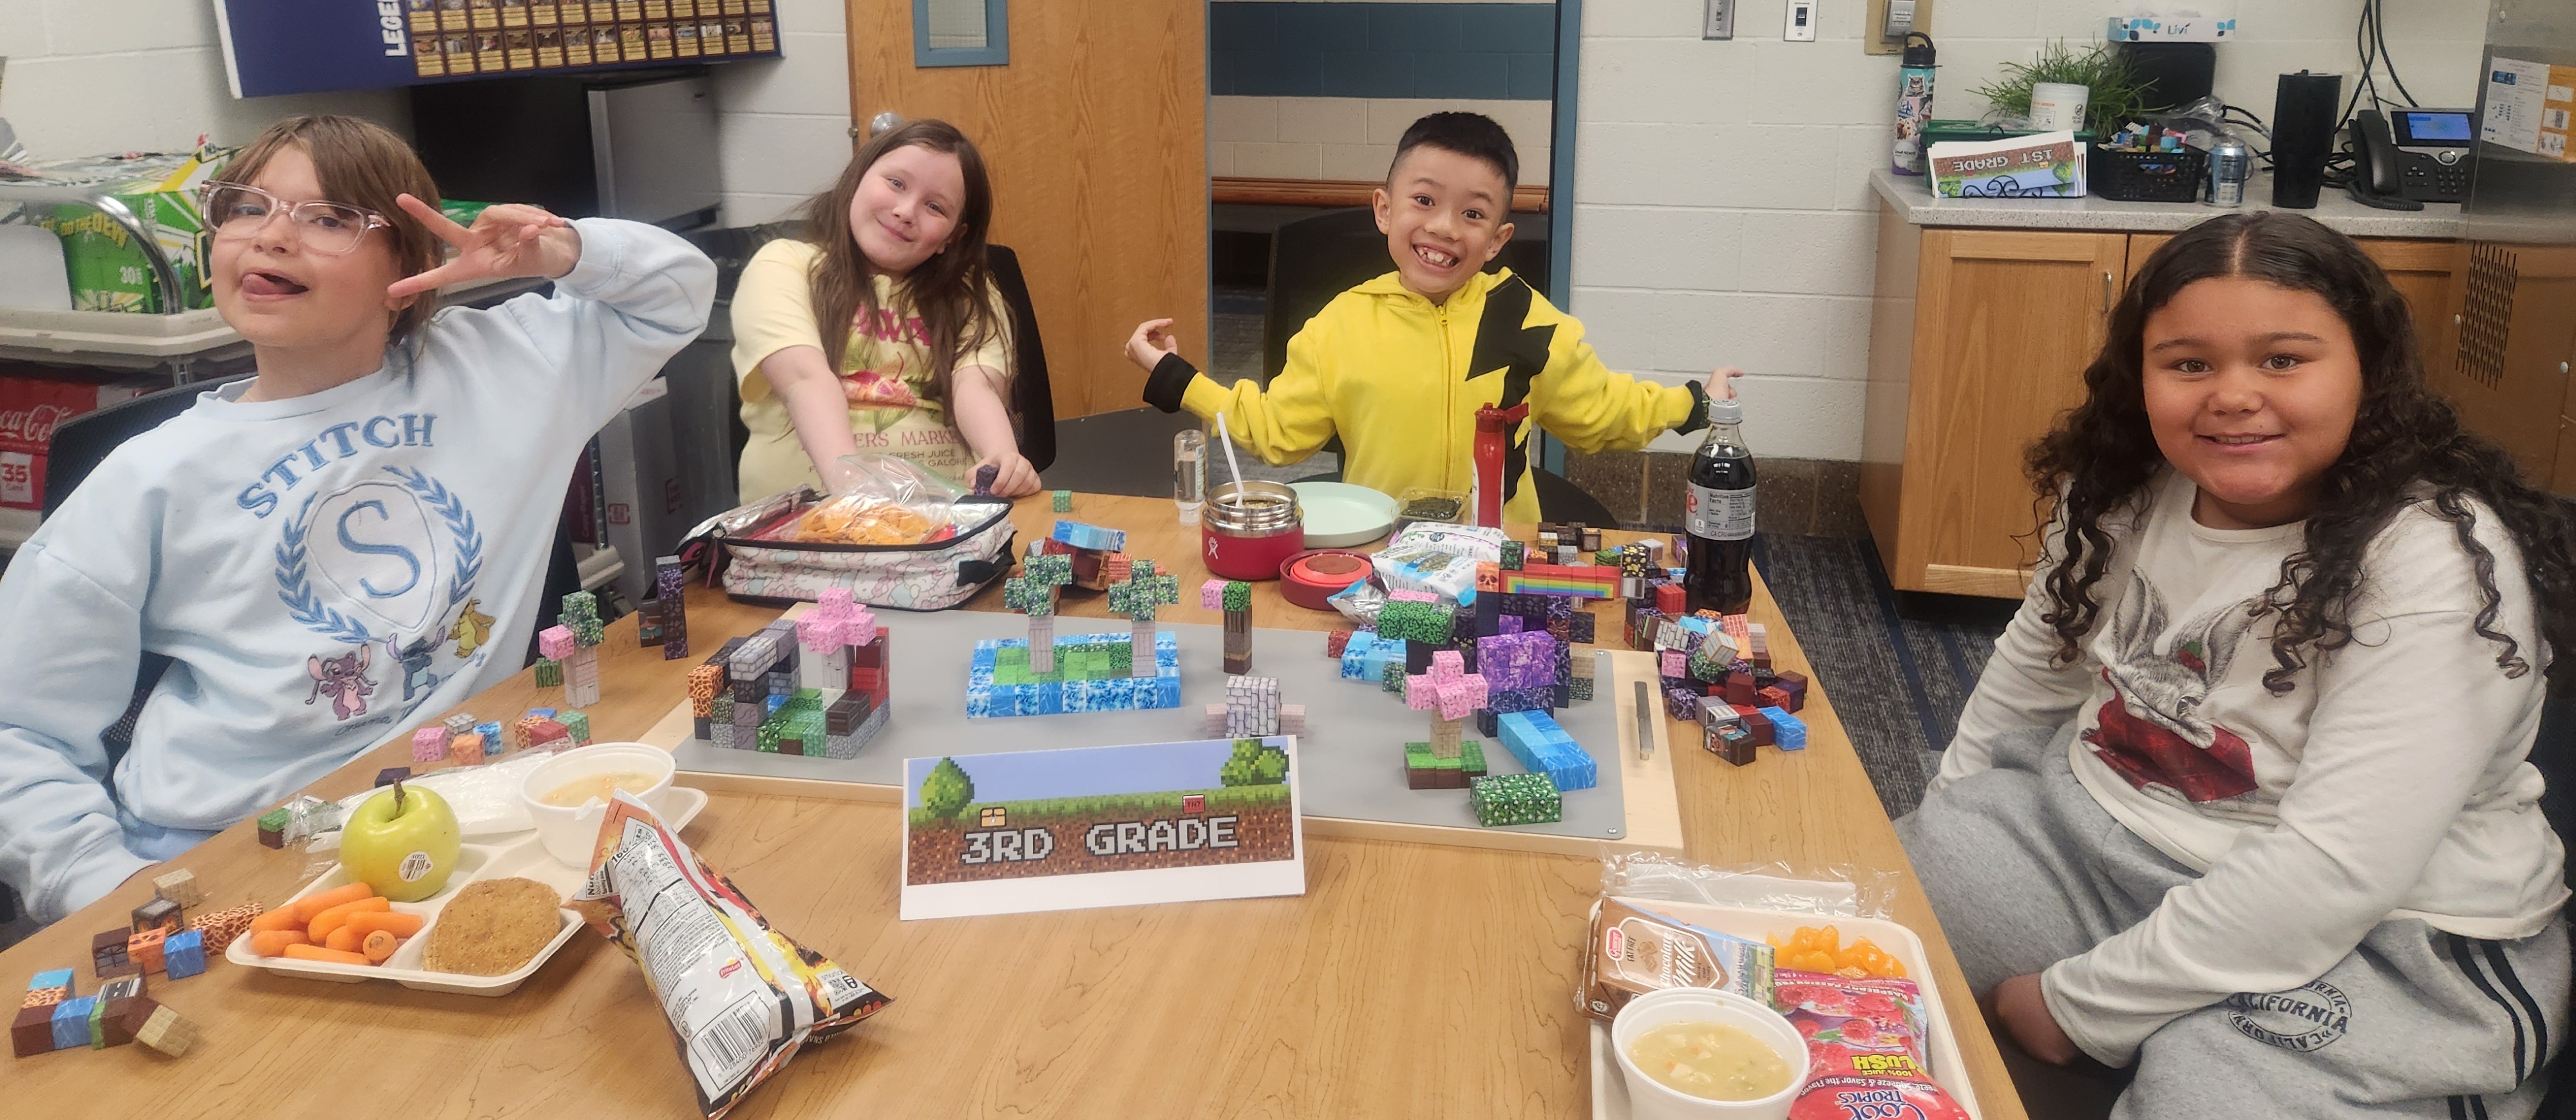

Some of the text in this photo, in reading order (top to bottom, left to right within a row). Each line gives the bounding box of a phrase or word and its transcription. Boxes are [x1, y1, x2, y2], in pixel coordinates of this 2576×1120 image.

[377, 0, 408, 57] LEGE
[2168, 23, 2191, 35] Livi
[1954, 149, 2052, 172] 1ST GRADE
[92, 211, 128, 249] DEW
[902, 430, 961, 446] MARKE
[236, 412, 438, 519] STITCH
[928, 449, 956, 459] JUICE
[1, 464, 27, 483] 35
[336, 499, 421, 599] S
[962, 815, 1238, 864] 3RD GRADE
[1627, 935, 1637, 962] FAT FREE
[1658, 932, 1673, 988] Chocolate
[1672, 938, 1698, 989] Milk
[1846, 985, 1909, 1001] RASPBERRY
[2232, 1012, 2324, 1049] CALIFORN
[1824, 1076, 1841, 1085] the
[1841, 1076, 1868, 1087] Savor
[1868, 1078, 1875, 1087] &
[1838, 1089, 1906, 1104] TROPICS
